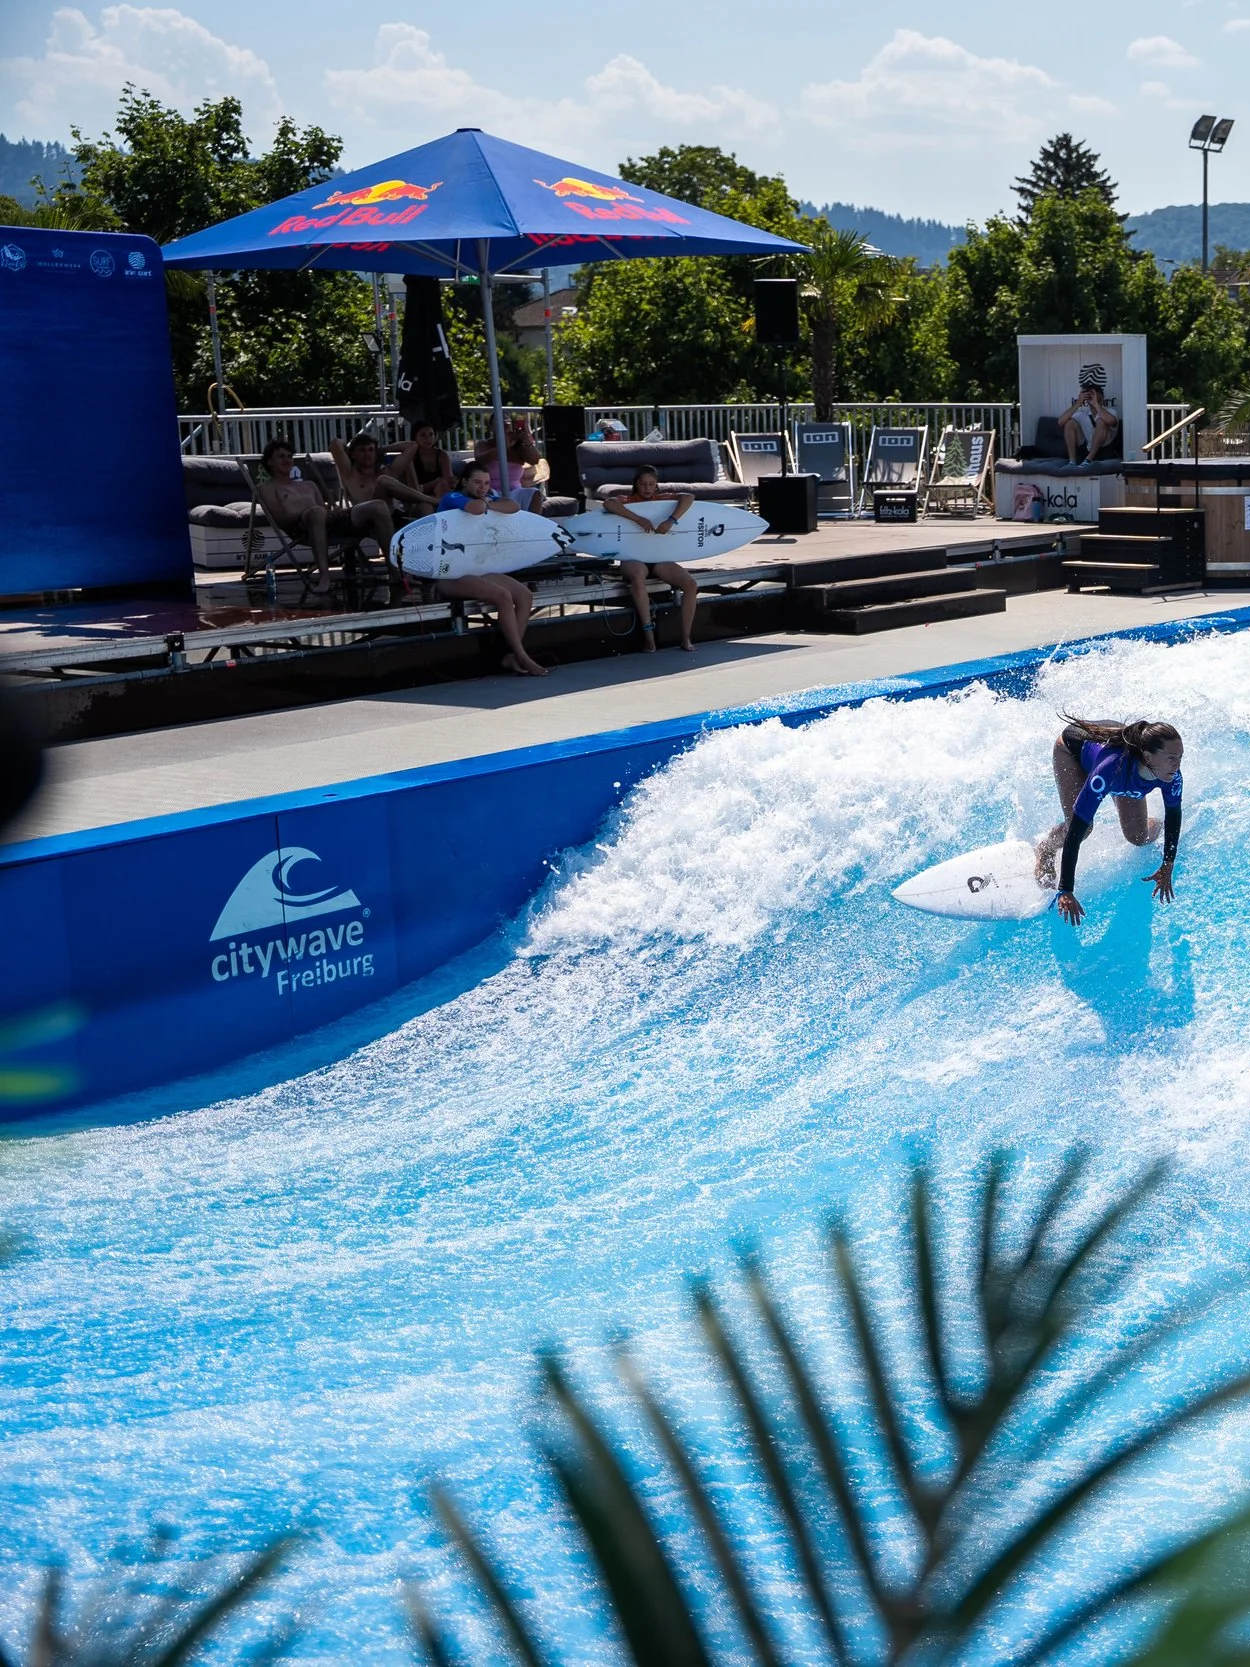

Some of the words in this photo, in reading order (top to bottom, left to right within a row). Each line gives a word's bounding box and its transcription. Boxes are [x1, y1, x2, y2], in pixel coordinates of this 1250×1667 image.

[267, 207, 352, 237] Red
[337, 204, 429, 226] Bull
[697, 516, 705, 548] VISITOR
[211, 920, 364, 982] citywave
[276, 953, 375, 996] Freiburg
